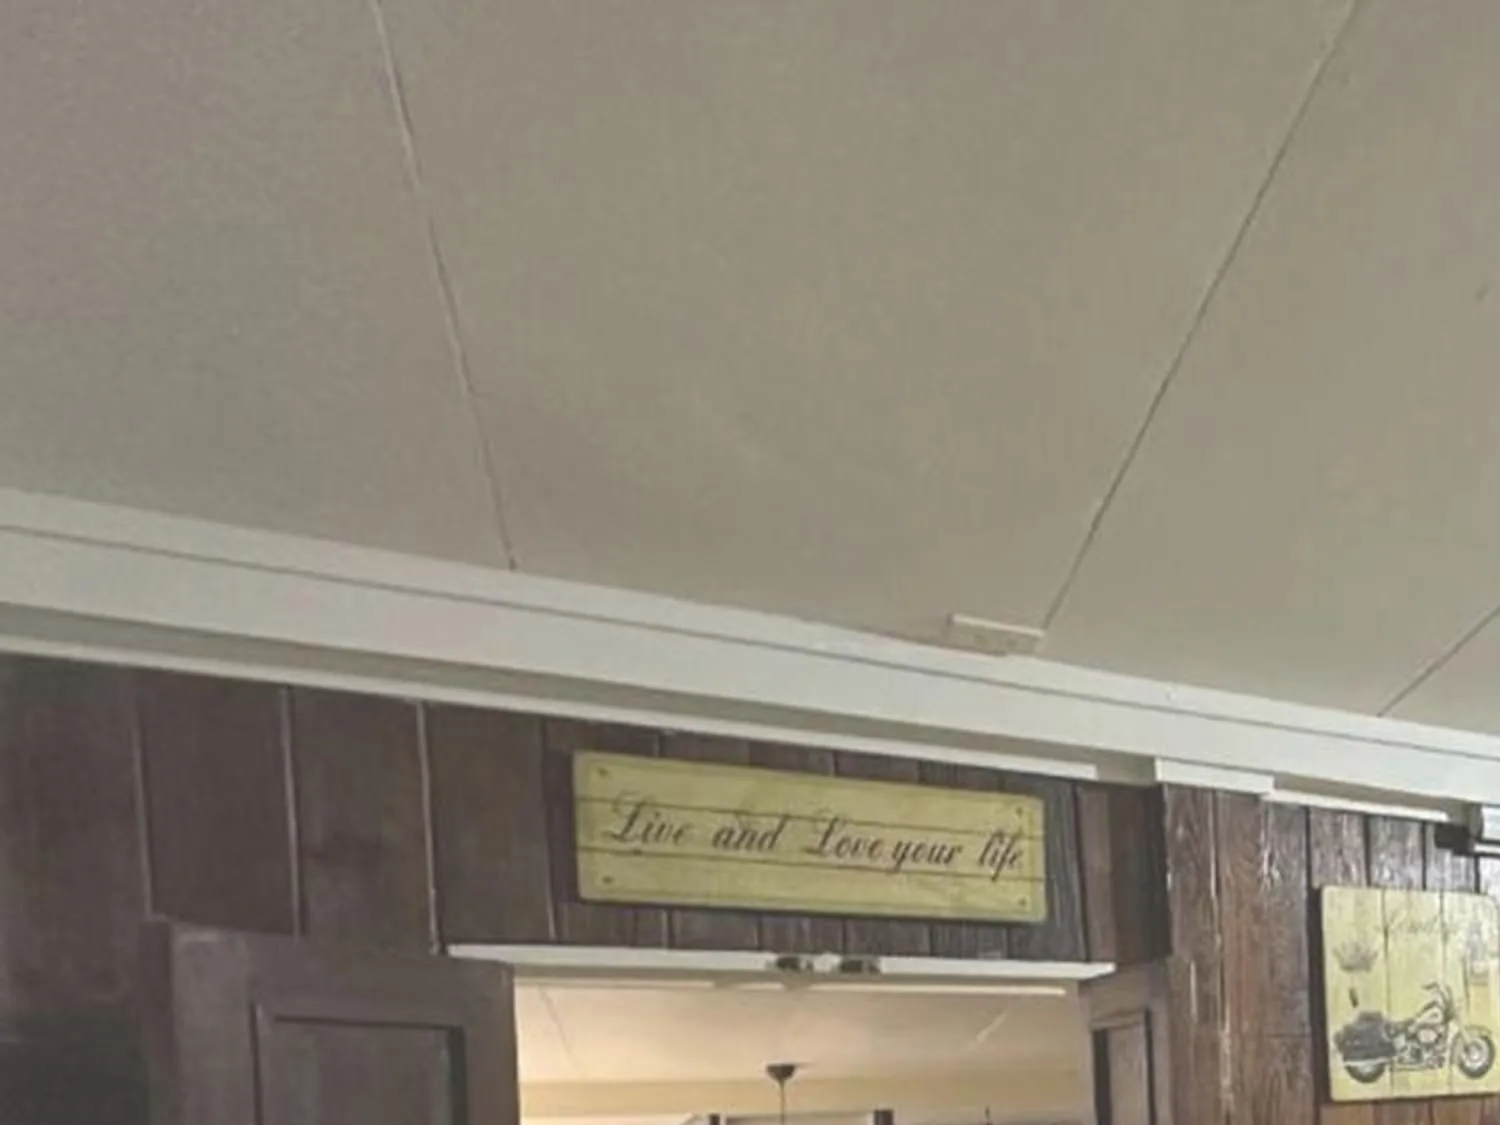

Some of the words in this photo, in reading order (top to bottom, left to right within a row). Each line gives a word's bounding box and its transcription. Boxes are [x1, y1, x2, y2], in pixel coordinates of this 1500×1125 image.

[712, 813, 791, 852] and
[803, 811, 883, 861] Love
[890, 838, 963, 874] your
